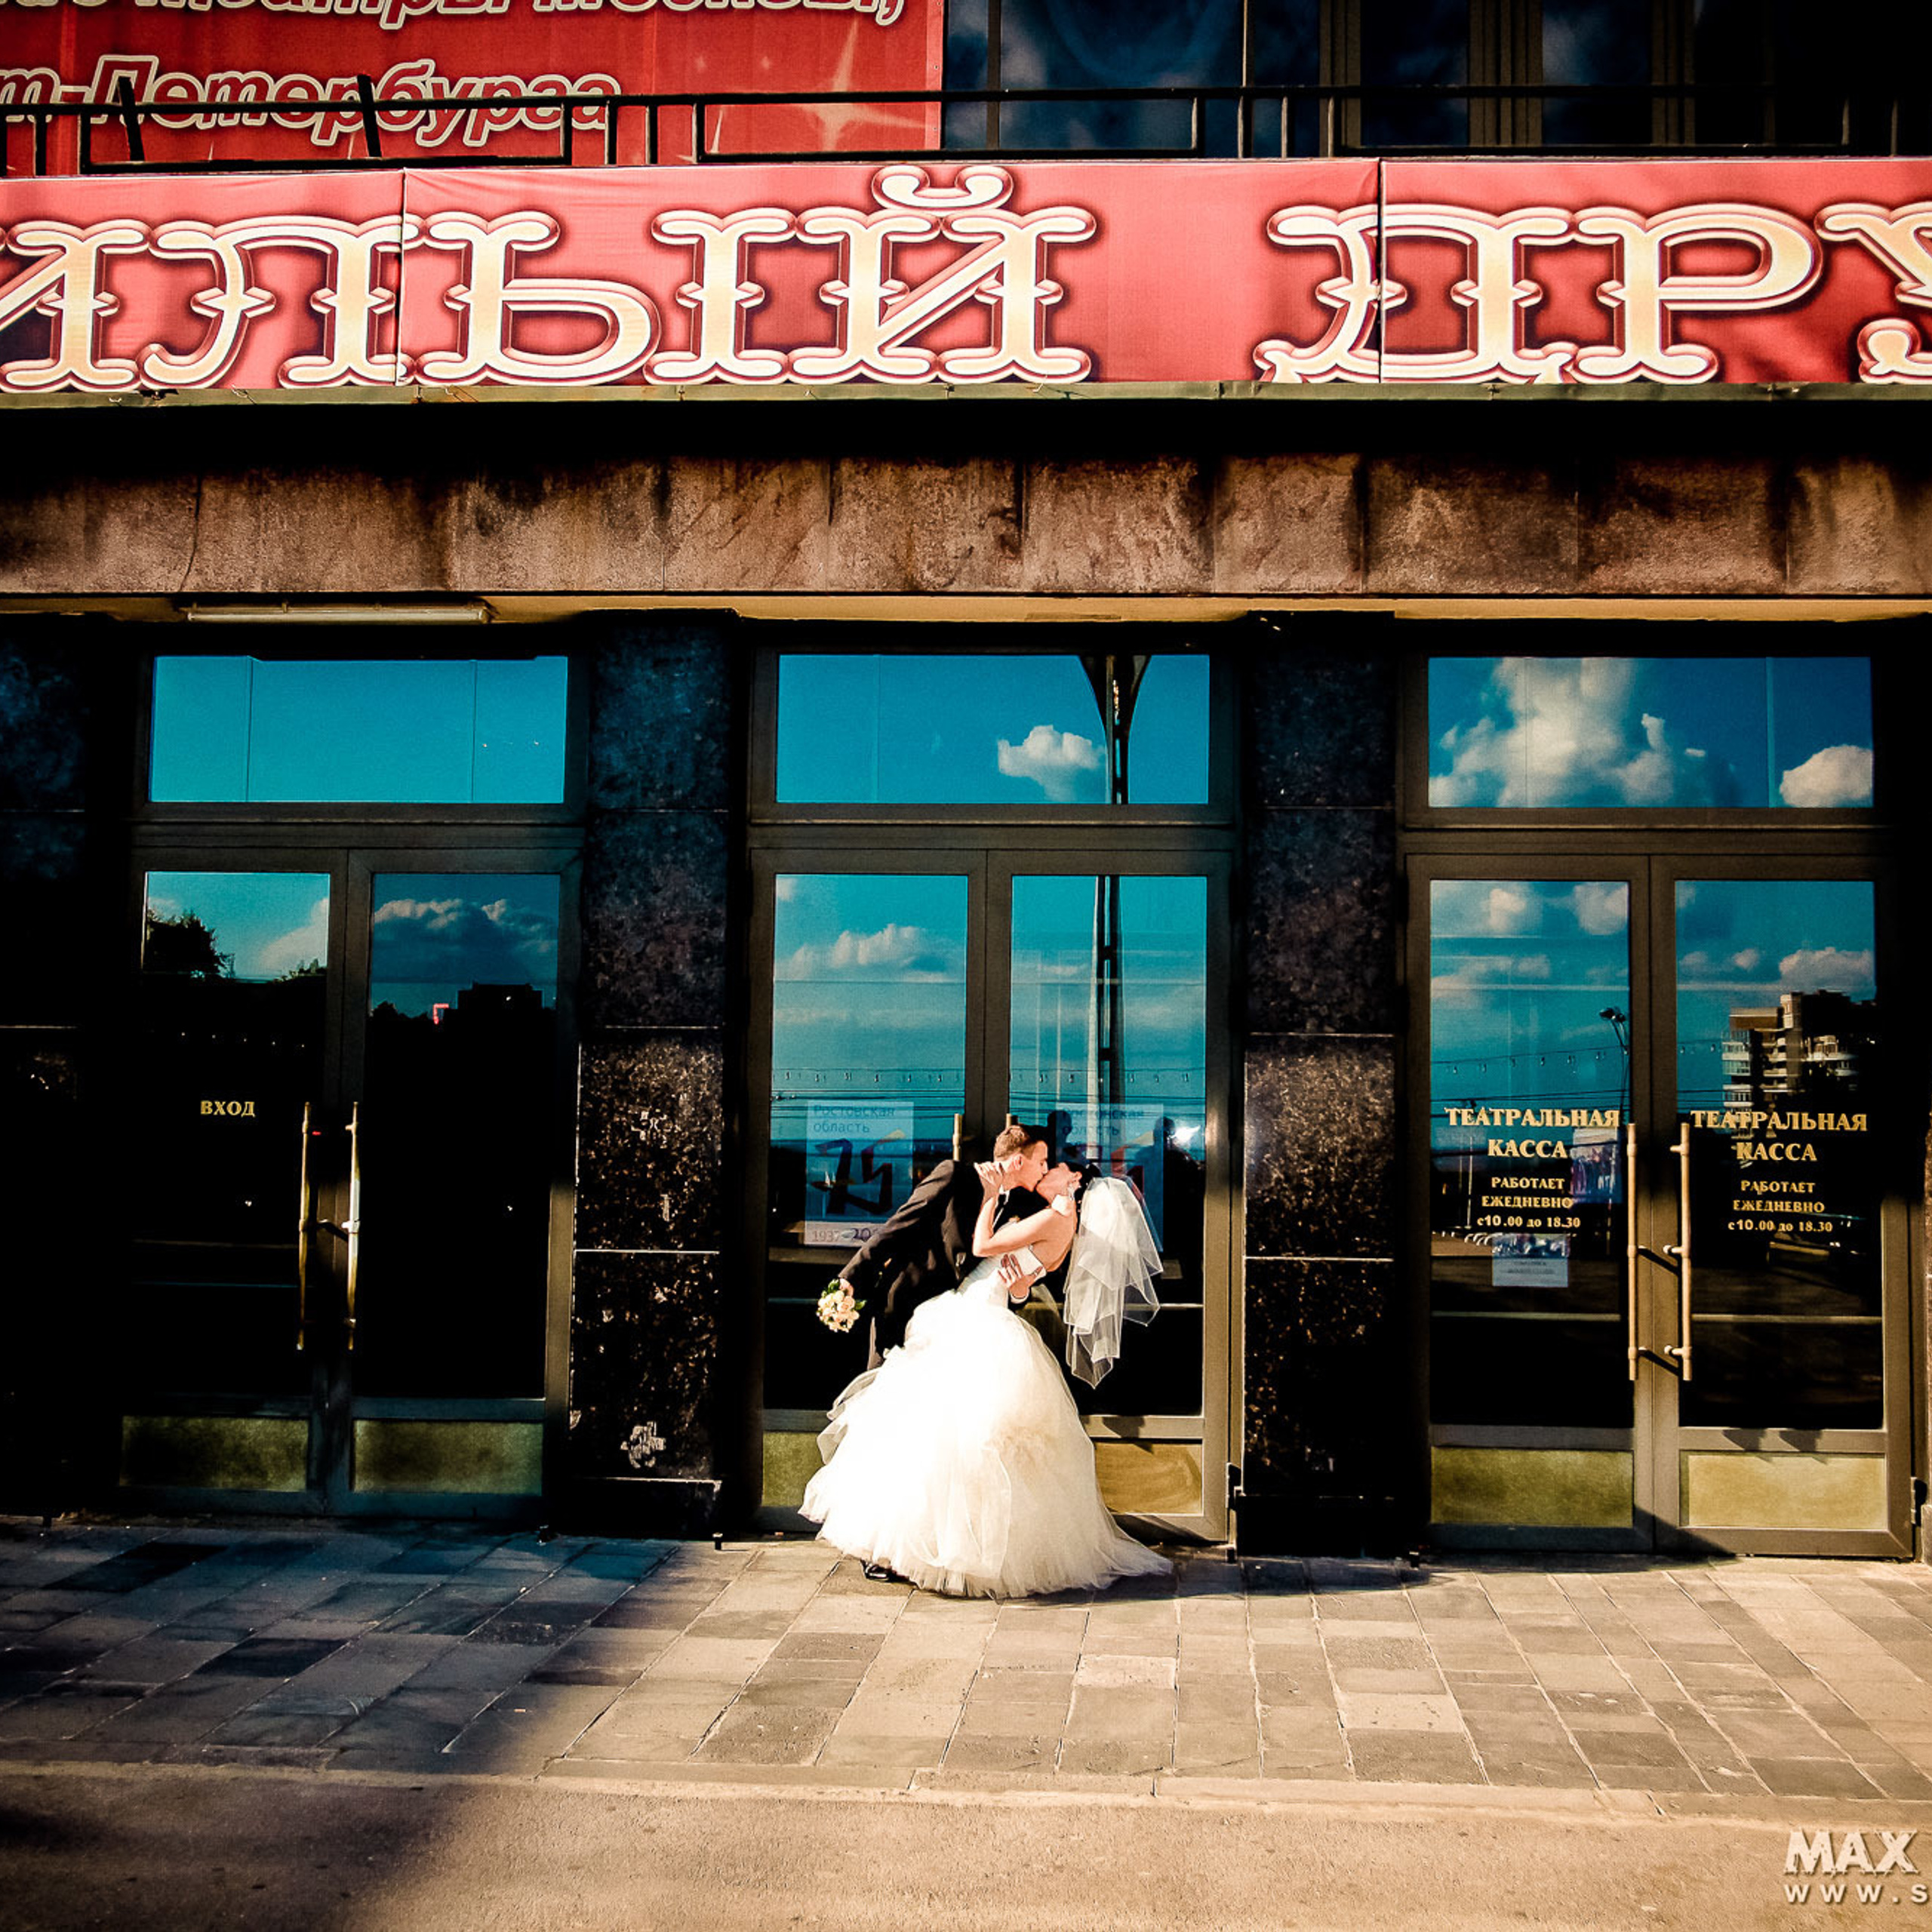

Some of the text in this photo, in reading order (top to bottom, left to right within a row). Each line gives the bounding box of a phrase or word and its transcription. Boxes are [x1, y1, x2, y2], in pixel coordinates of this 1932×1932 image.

[200, 1100, 256, 1118] ВХОД
[813, 1104, 896, 1118] Ростовская
[1444, 1107, 1620, 1128] ТЕАТРАЛЬНАЯ
[1690, 1110, 1868, 1131] ТЕАТРАЛЬНАЯ
[813, 1121, 870, 1133] область
[1487, 1139, 1567, 1158] КАССА
[1736, 1142, 1817, 1161] КАССА
[1491, 1177, 1565, 1190] РАБОТАЕТ
[1740, 1180, 1816, 1193] РАБОТАЕТ
[1481, 1195, 1574, 1208] ЕЖЕДНЕВНО
[1733, 1199, 1825, 1213] ЕЖЕДНЕВНО
[1526, 1218, 1542, 1229] до
[1546, 1217, 1581, 1229] 18.30
[1777, 1221, 1793, 1232] до
[1798, 1221, 1833, 1232] 18.30
